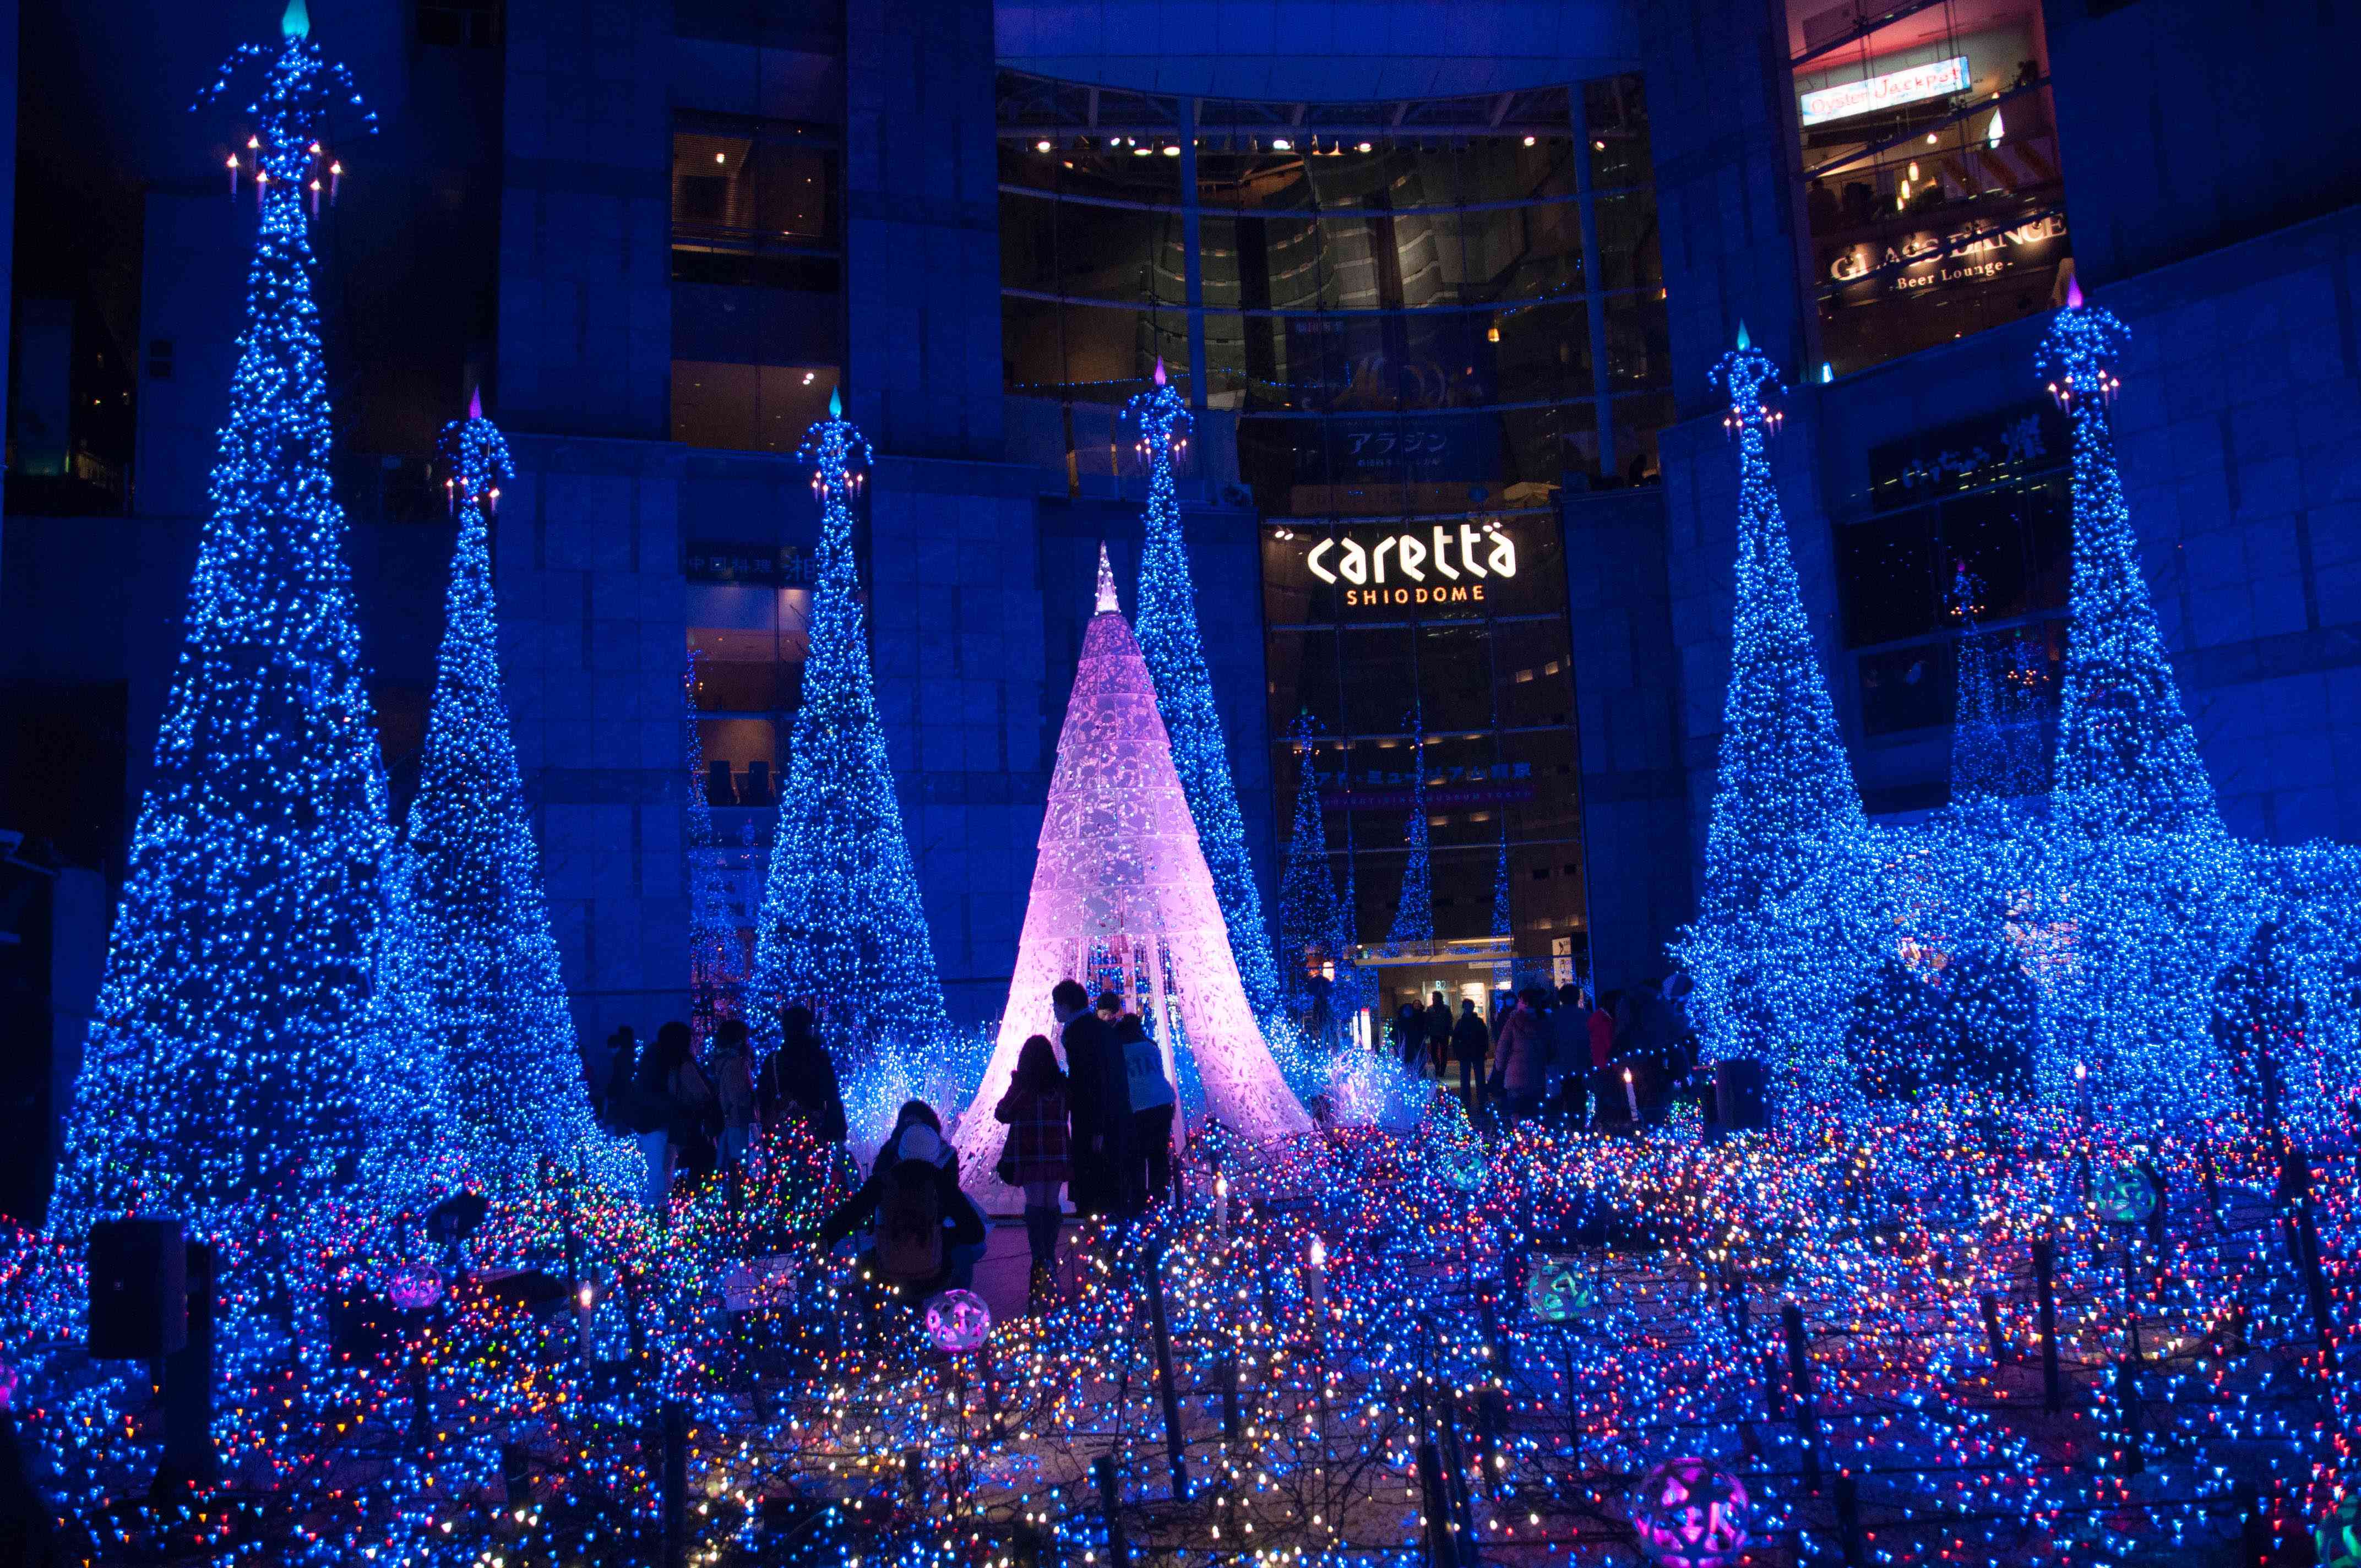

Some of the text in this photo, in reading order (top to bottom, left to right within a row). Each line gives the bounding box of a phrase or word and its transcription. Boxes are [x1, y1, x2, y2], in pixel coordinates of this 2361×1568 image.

[1811, 66, 1962, 115] Oyster Jackpot
[1897, 261, 2004, 290] Beer Lounge
[1347, 432, 1447, 455] アラジン
[1308, 524, 1516, 585] caretta
[1347, 585, 1484, 606] SHIODOME
[1435, 980, 1446, 990] B2
